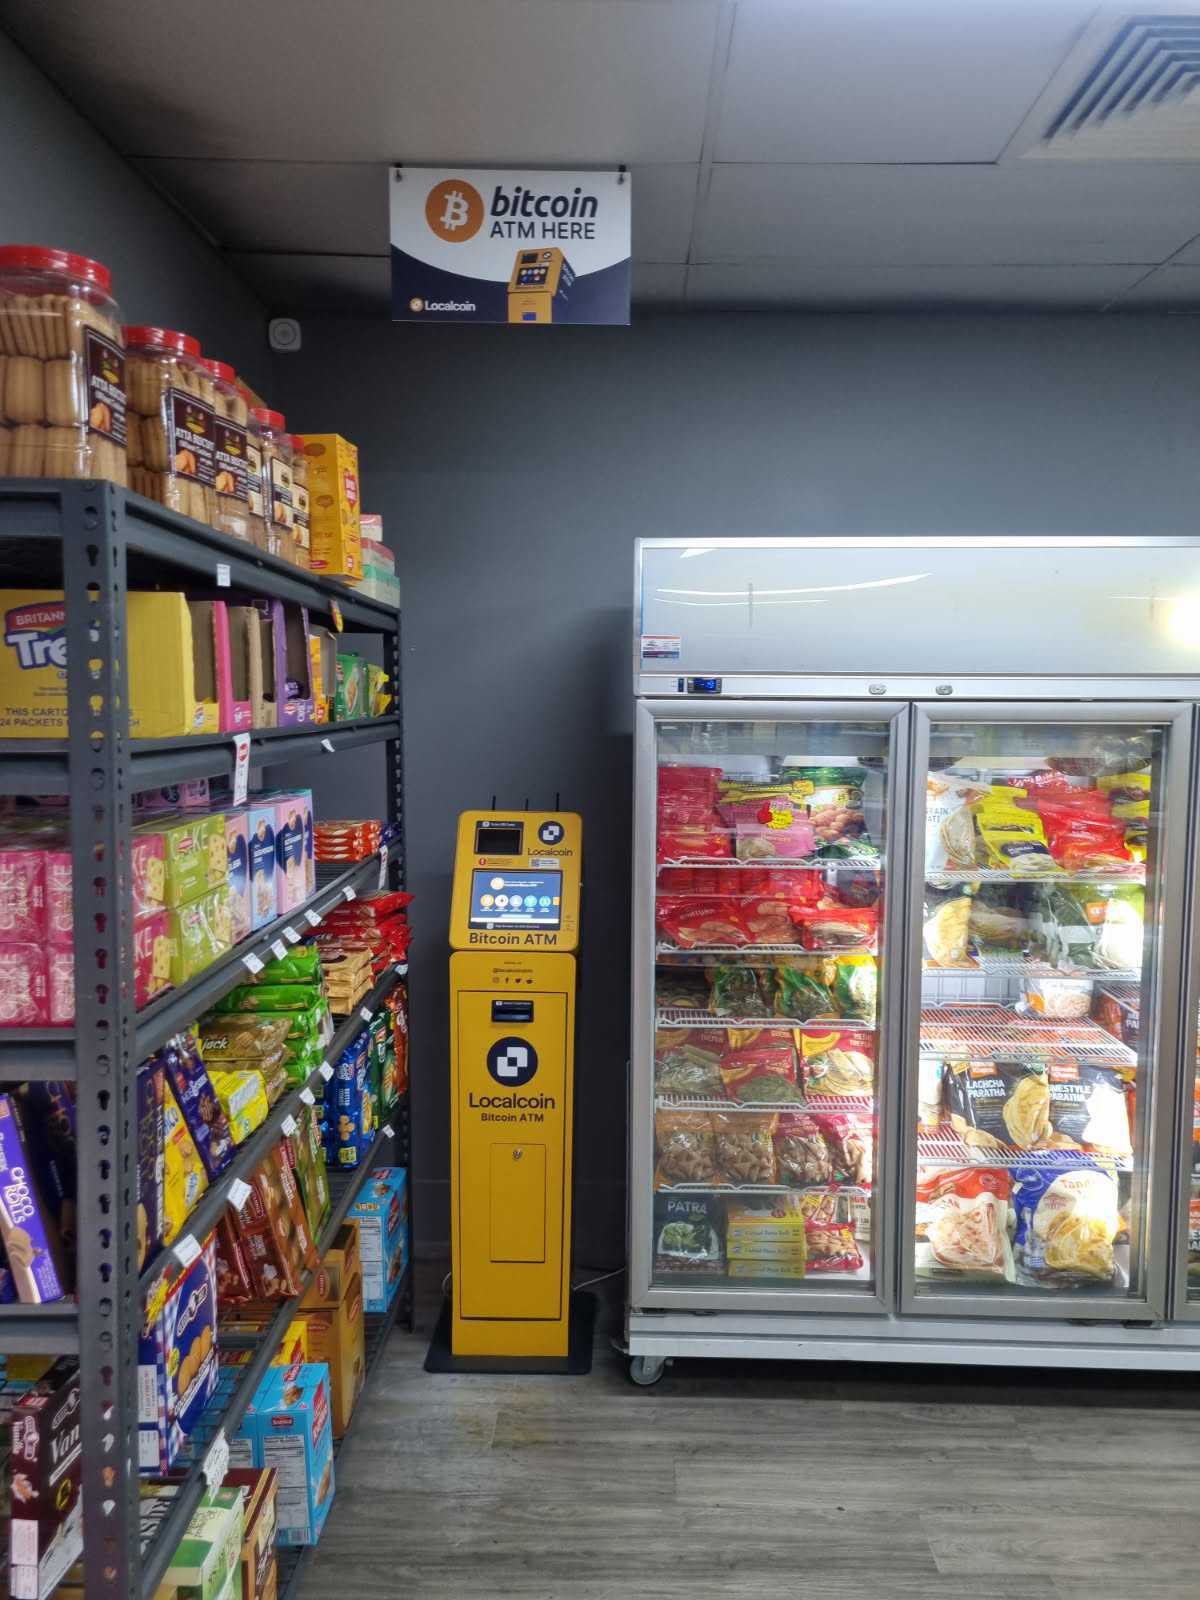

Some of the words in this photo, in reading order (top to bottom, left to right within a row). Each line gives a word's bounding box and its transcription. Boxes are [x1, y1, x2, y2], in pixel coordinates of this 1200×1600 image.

[490, 186, 598, 219] bitcoin
[490, 221, 535, 239] ATM
[542, 222, 596, 240] HERE
[424, 300, 477, 313] Localcoin
[6, 707, 29, 717] THIS
[14, 718, 64, 727] PACKETS
[528, 847, 574, 857] Localcoin
[469, 932, 520, 945] Bitcoin
[524, 934, 558, 945] ATM
[202, 1036, 229, 1051] jack
[966, 1080, 1005, 1089] LACHCHA
[968, 1089, 1006, 1098] PARATHA
[469, 1092, 556, 1109] Localcoin
[481, 1113, 517, 1122] Bitcoin
[519, 1113, 544, 1122] ATM
[11, 1166, 35, 1217] CHOCO
[3, 1184, 26, 1224] ROLLS
